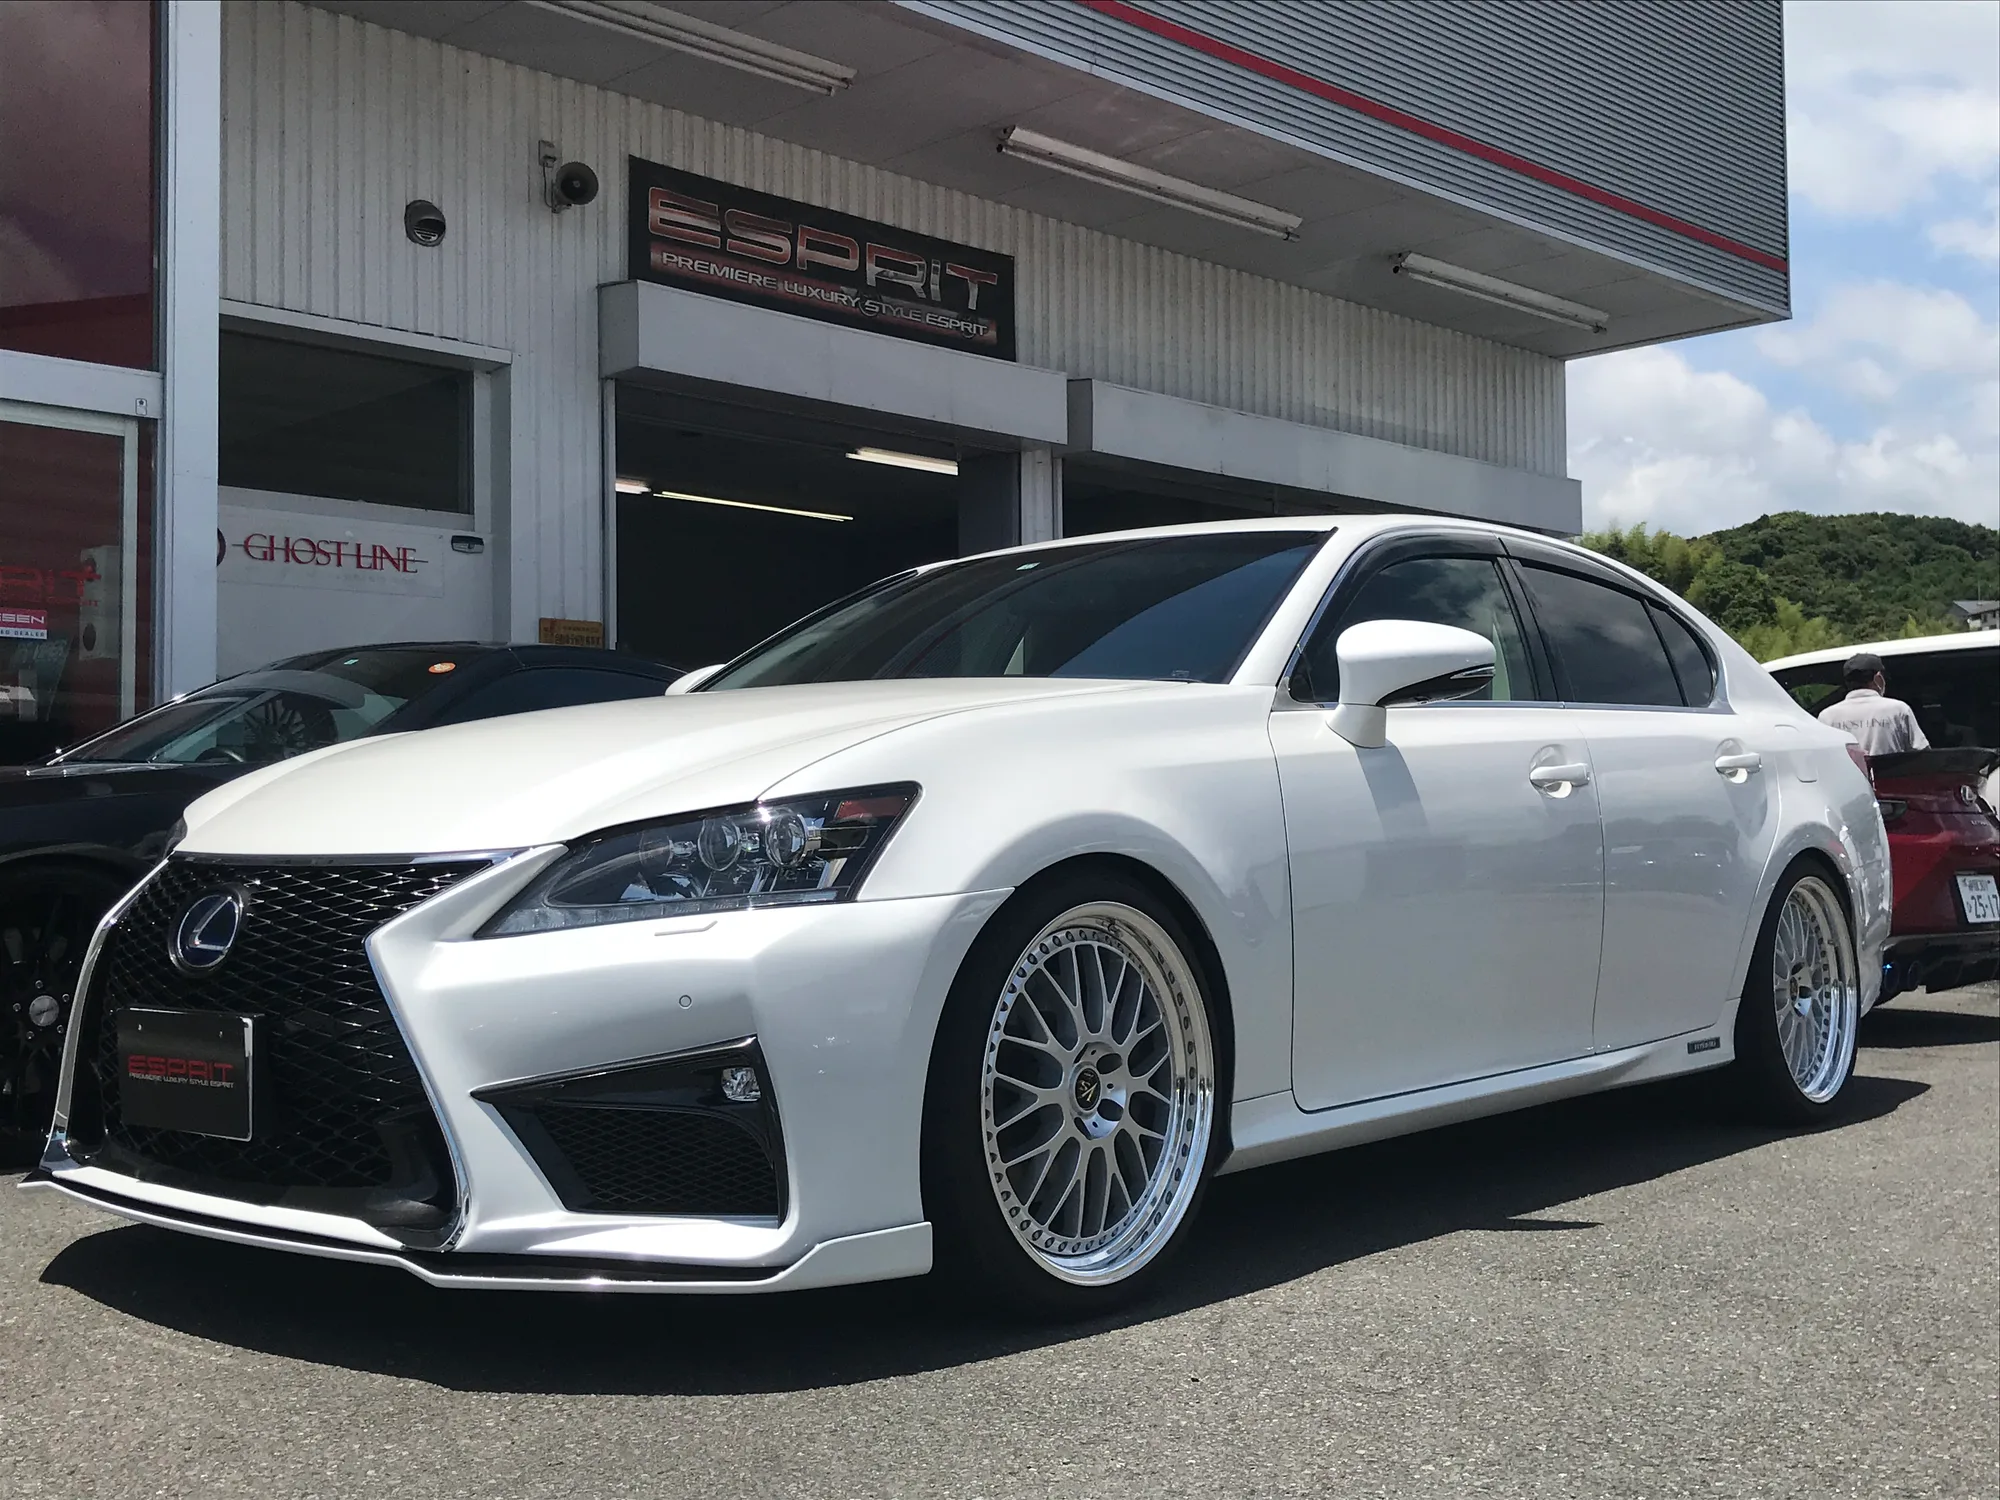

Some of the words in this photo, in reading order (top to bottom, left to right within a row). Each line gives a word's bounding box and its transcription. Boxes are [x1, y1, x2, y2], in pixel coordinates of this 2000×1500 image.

[662, 252, 777, 289] PREMIERE
[784, 280, 860, 308] LUXURY
[864, 299, 922, 322] STYLE
[925, 312, 988, 336] ESPRIT
[243, 532, 349, 568] GHOST
[355, 542, 418, 574] LINE
[0, 613, 44, 625] SEN
[128, 1055, 233, 1082] ESPRIT
